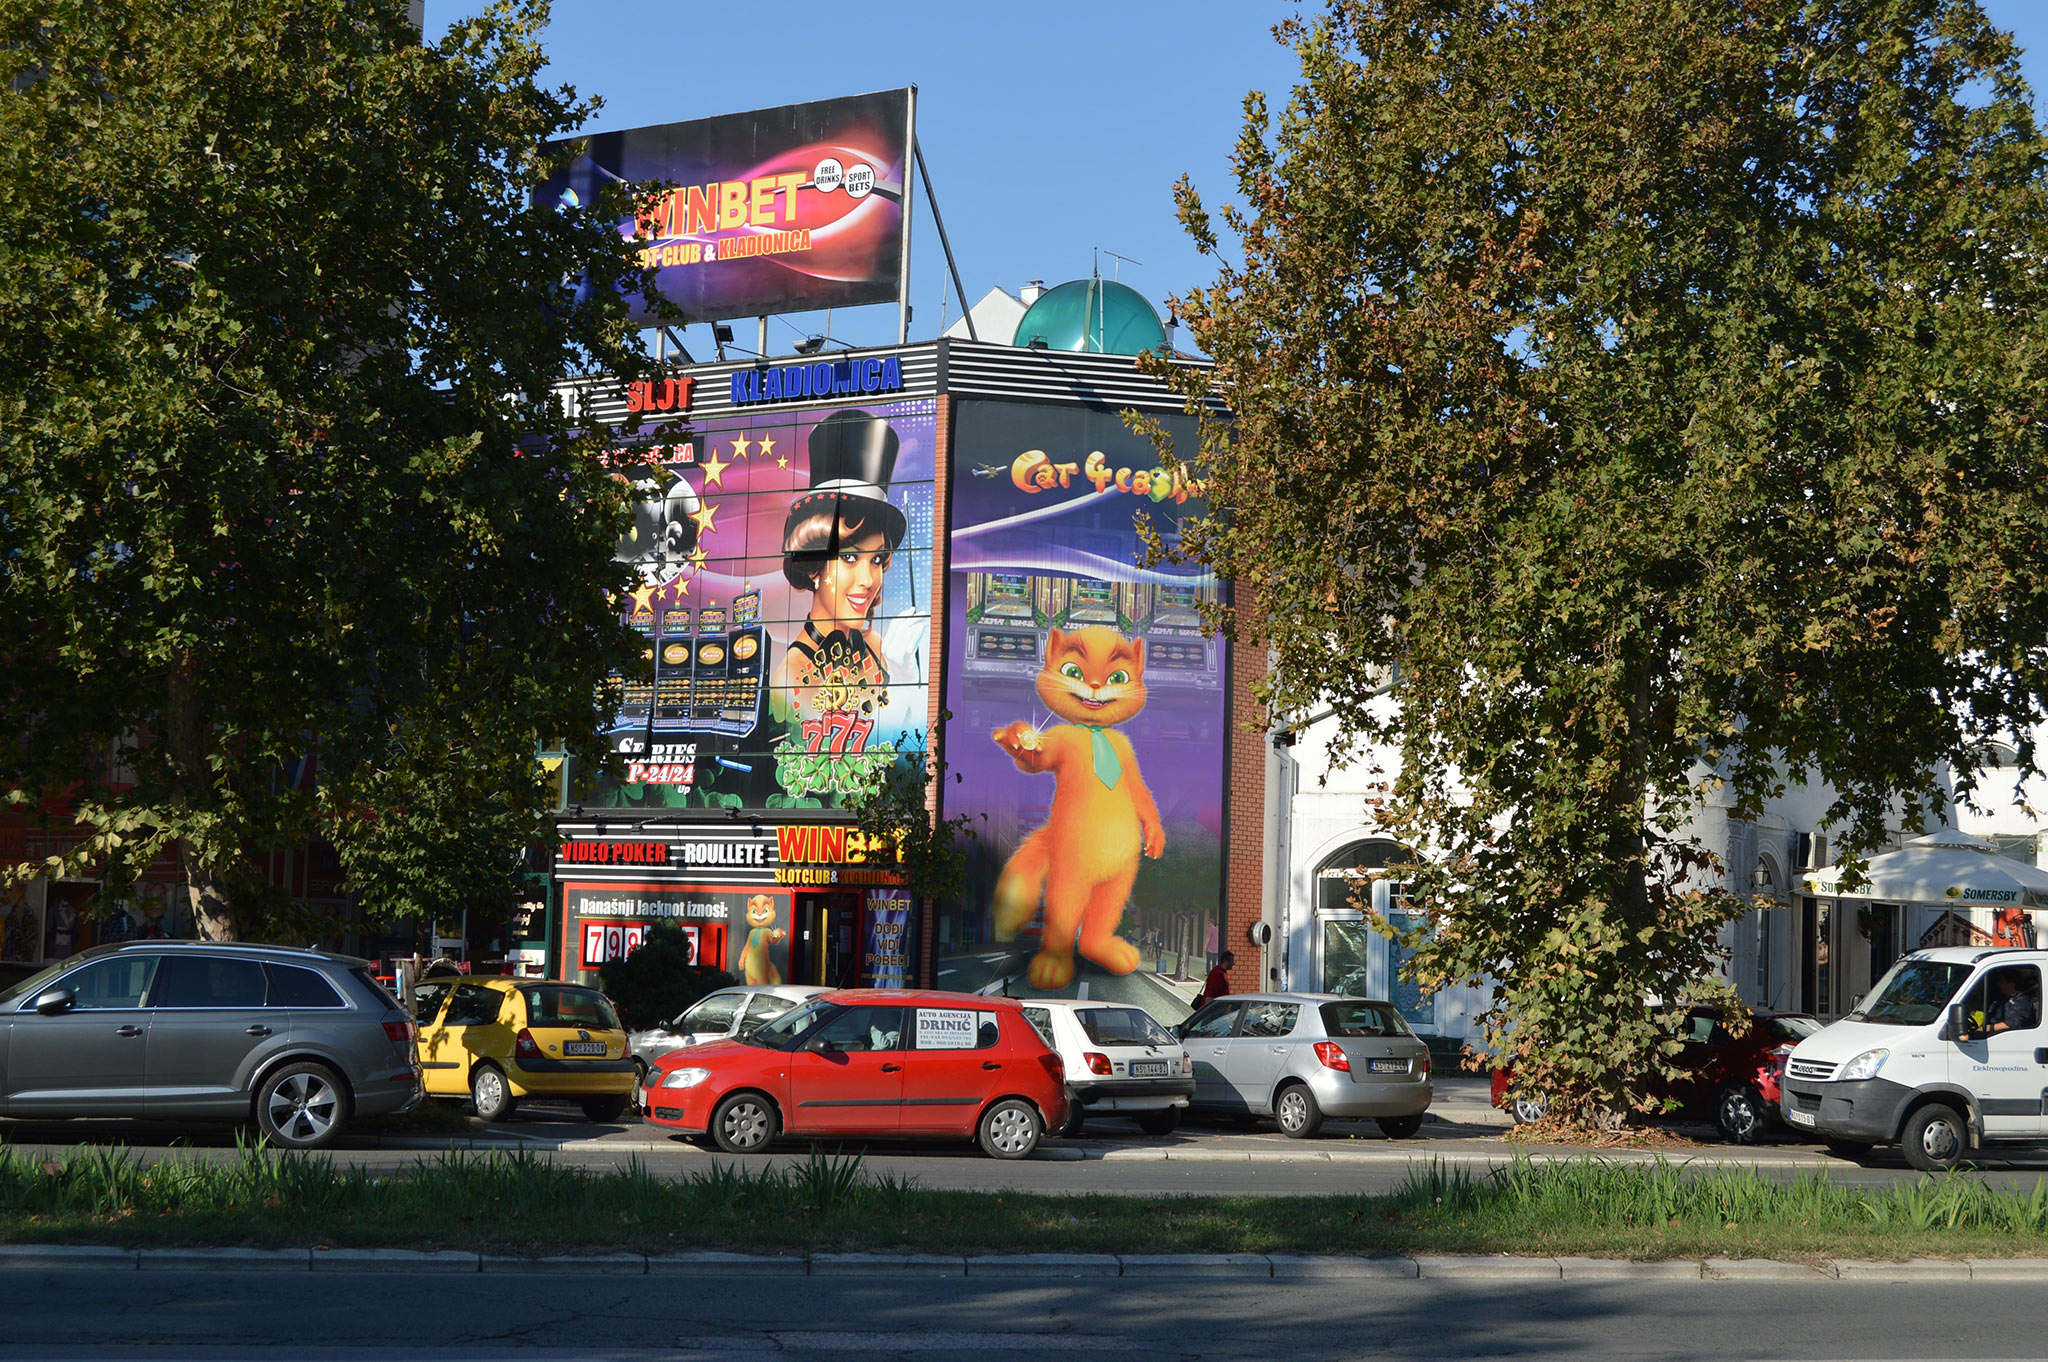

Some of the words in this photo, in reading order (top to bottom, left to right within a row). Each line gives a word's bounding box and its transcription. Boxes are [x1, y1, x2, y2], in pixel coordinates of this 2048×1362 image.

[821, 165, 835, 175] FREE
[848, 171, 871, 182] SPORT
[816, 174, 840, 184] DRINKS
[848, 182, 871, 192] BETS
[661, 243, 701, 267] CLUB
[703, 243, 717, 262] &
[718, 228, 812, 261] KLADIONICA
[626, 377, 695, 413] SLOT
[730, 357, 902, 404] KLADIONICA
[801, 709, 875, 759] 777
[626, 762, 695, 785] P-24/24
[677, 784, 691, 796] Up
[562, 843, 609, 862] VIDEO
[612, 843, 666, 863] POKER
[684, 843, 764, 865] ROULLETE
[580, 897, 634, 917] Današnji
[636, 899, 685, 918] Jackpot
[687, 901, 728, 919] iznosi:
[867, 898, 911, 911] WINBET
[877, 938, 900, 951] VIDI
[865, 953, 910, 967] POBEDI
[920, 1018, 971, 1031] DRINIĆ
